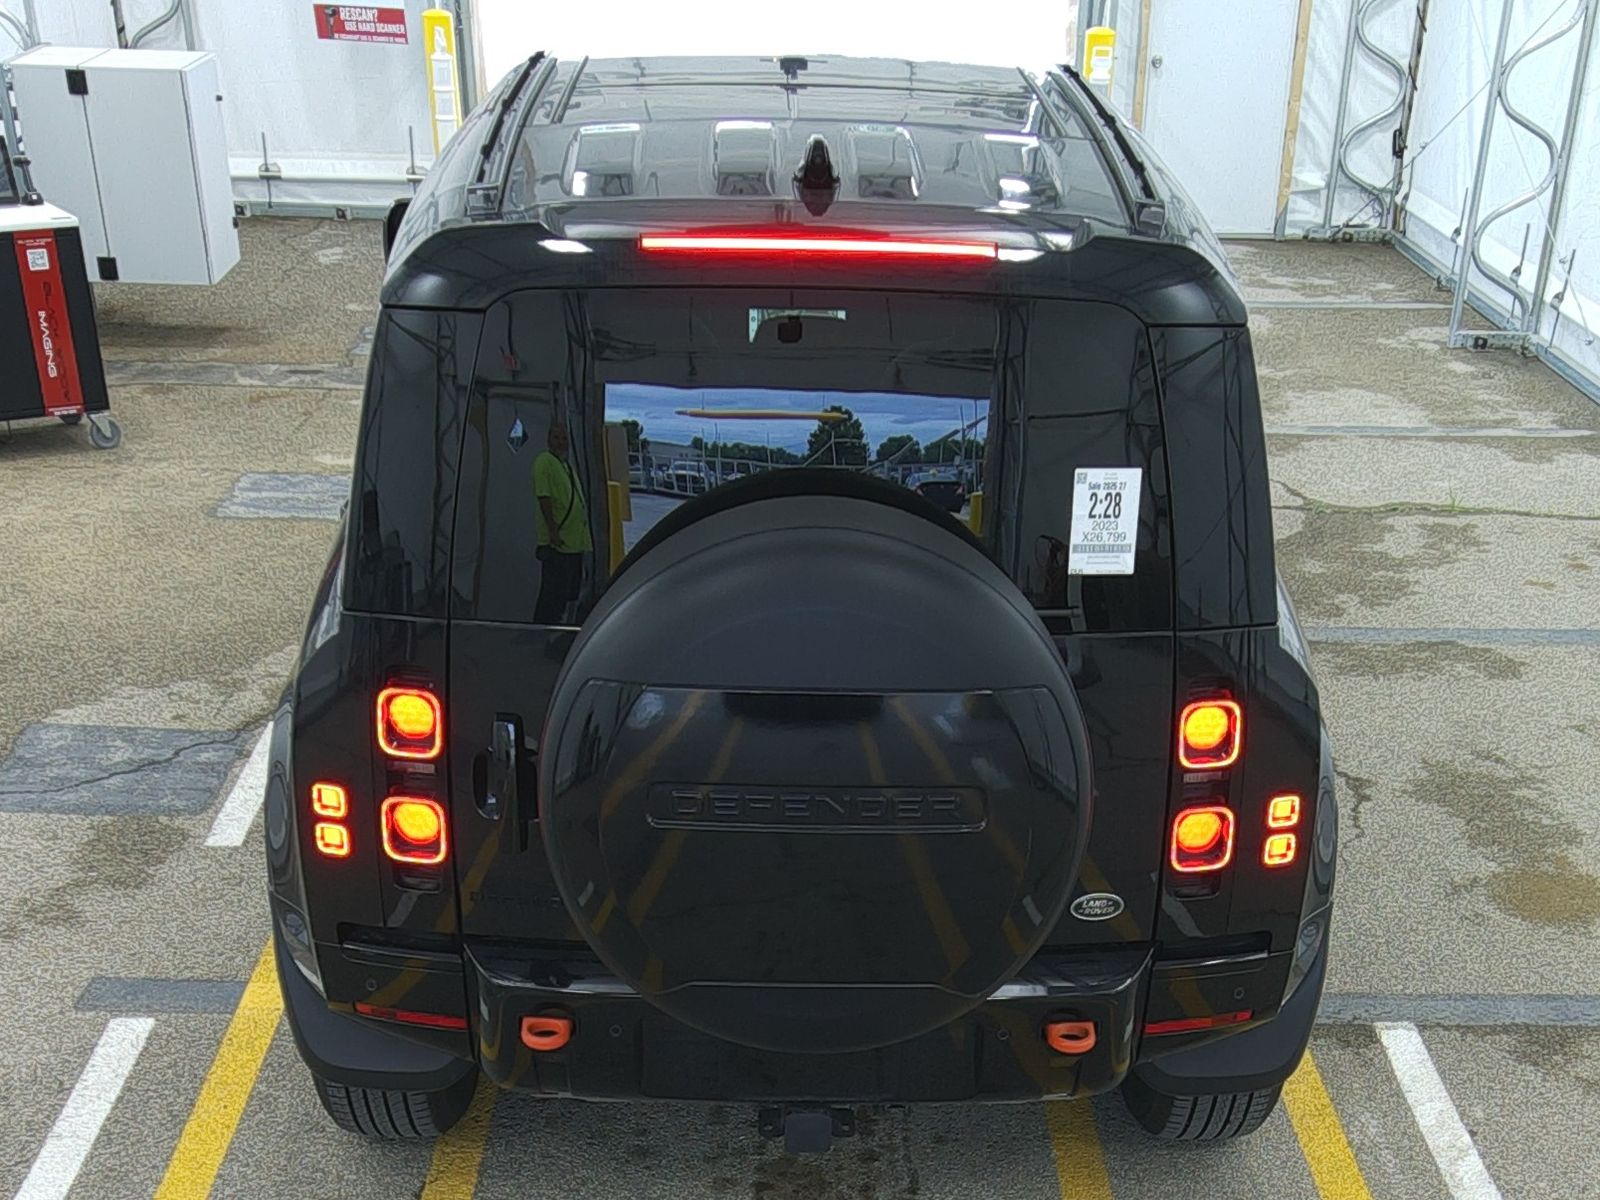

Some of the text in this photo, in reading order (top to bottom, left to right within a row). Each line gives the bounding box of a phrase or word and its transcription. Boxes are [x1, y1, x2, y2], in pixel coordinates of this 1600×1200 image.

[339, 7, 378, 21] RESCAN?
[38, 311, 58, 378] IMAGING
[1088, 492, 1122, 519] 2:28
[1092, 520, 1119, 531] 2023
[671, 790, 961, 818] DEFENDER
[1081, 900, 1108, 908] LAND
[1083, 906, 1115, 914] ROVER
